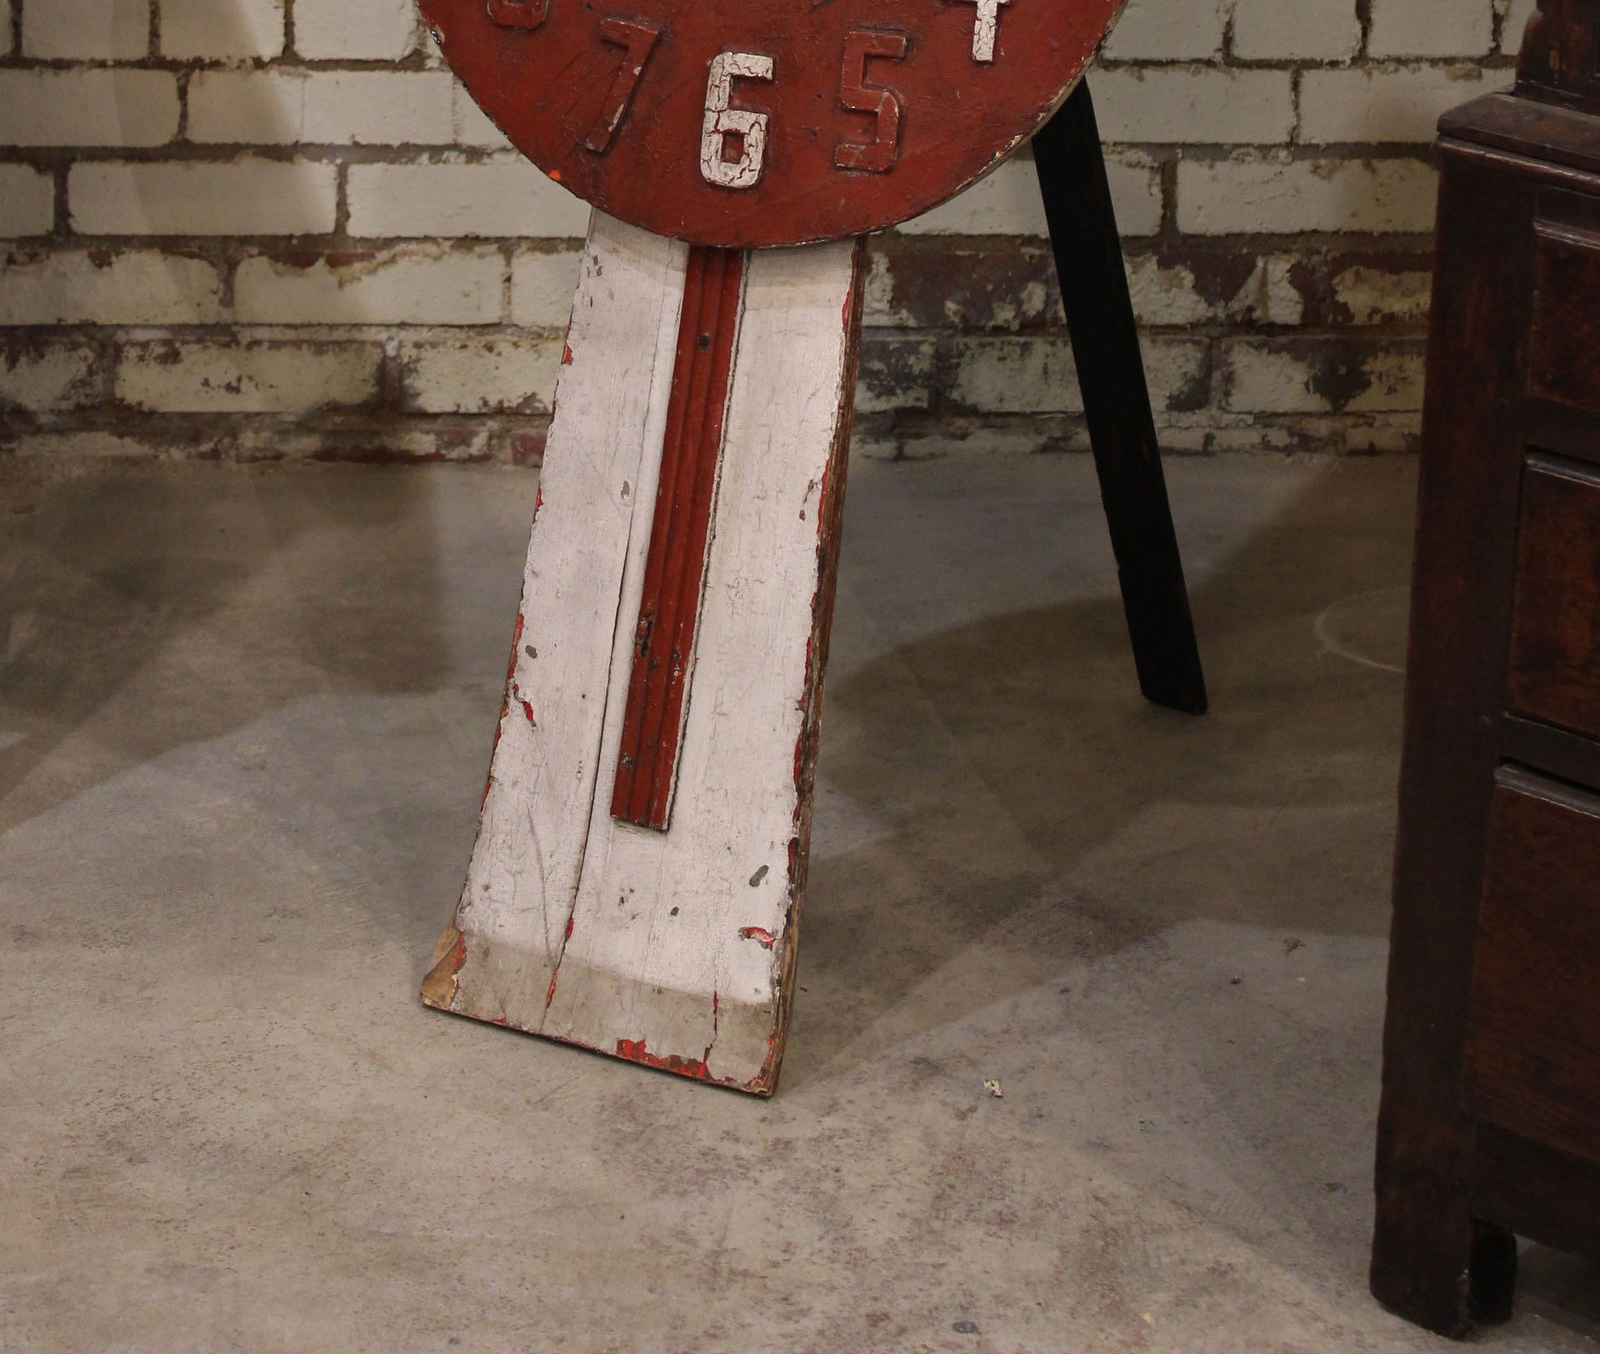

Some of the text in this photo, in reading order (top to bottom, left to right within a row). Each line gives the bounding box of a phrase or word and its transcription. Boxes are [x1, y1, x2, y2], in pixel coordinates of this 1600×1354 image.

[584, 16, 661, 154] 7
[700, 51, 775, 190] 6
[834, 28, 907, 174] 5
